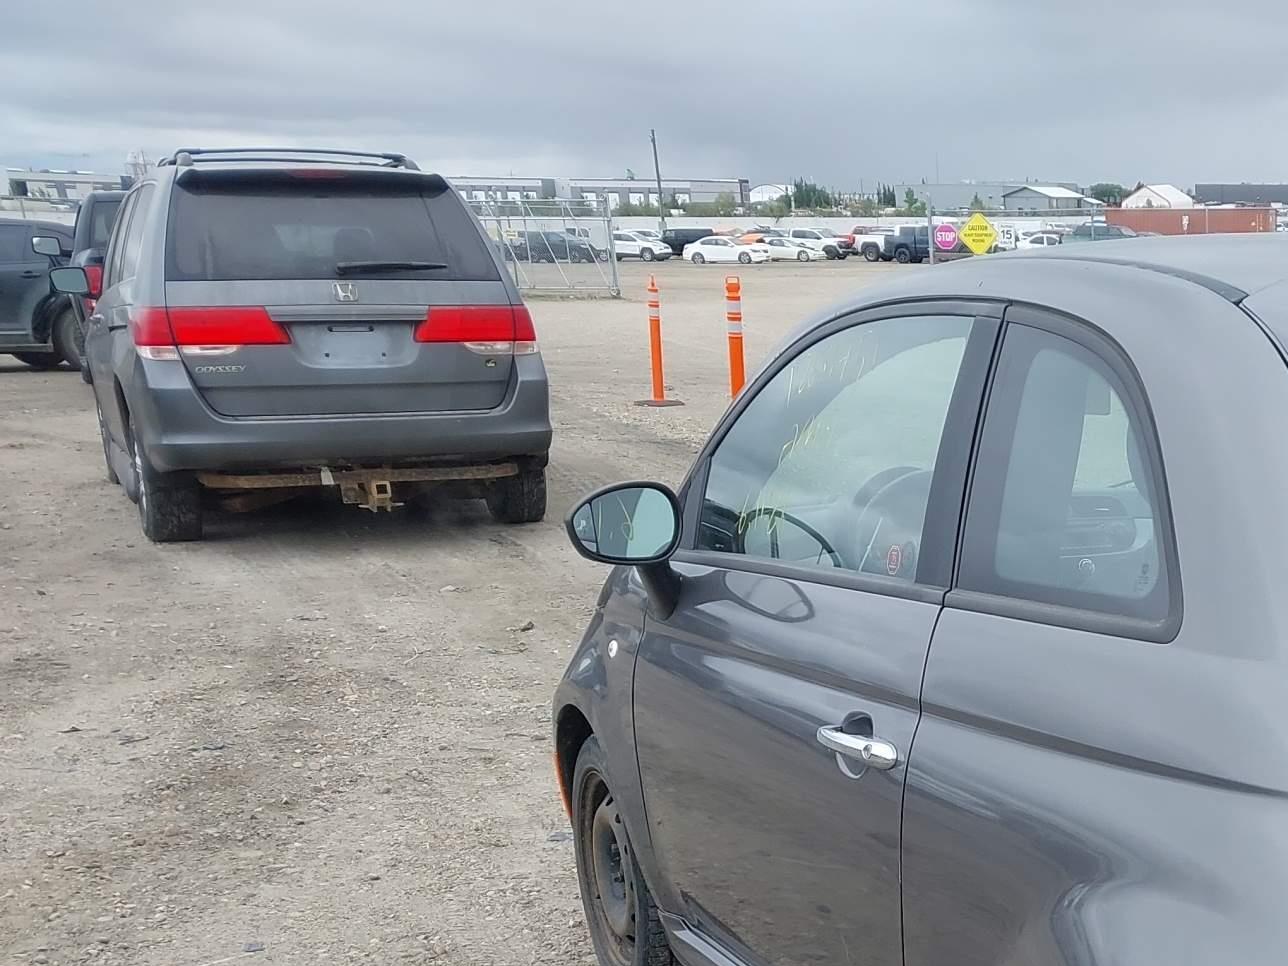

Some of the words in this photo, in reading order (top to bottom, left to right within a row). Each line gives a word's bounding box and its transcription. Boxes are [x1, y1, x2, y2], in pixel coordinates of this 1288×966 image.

[936, 231, 956, 242] STOP
[1000, 229, 1013, 240] 15
[194, 364, 247, 374] ODYSSEY
